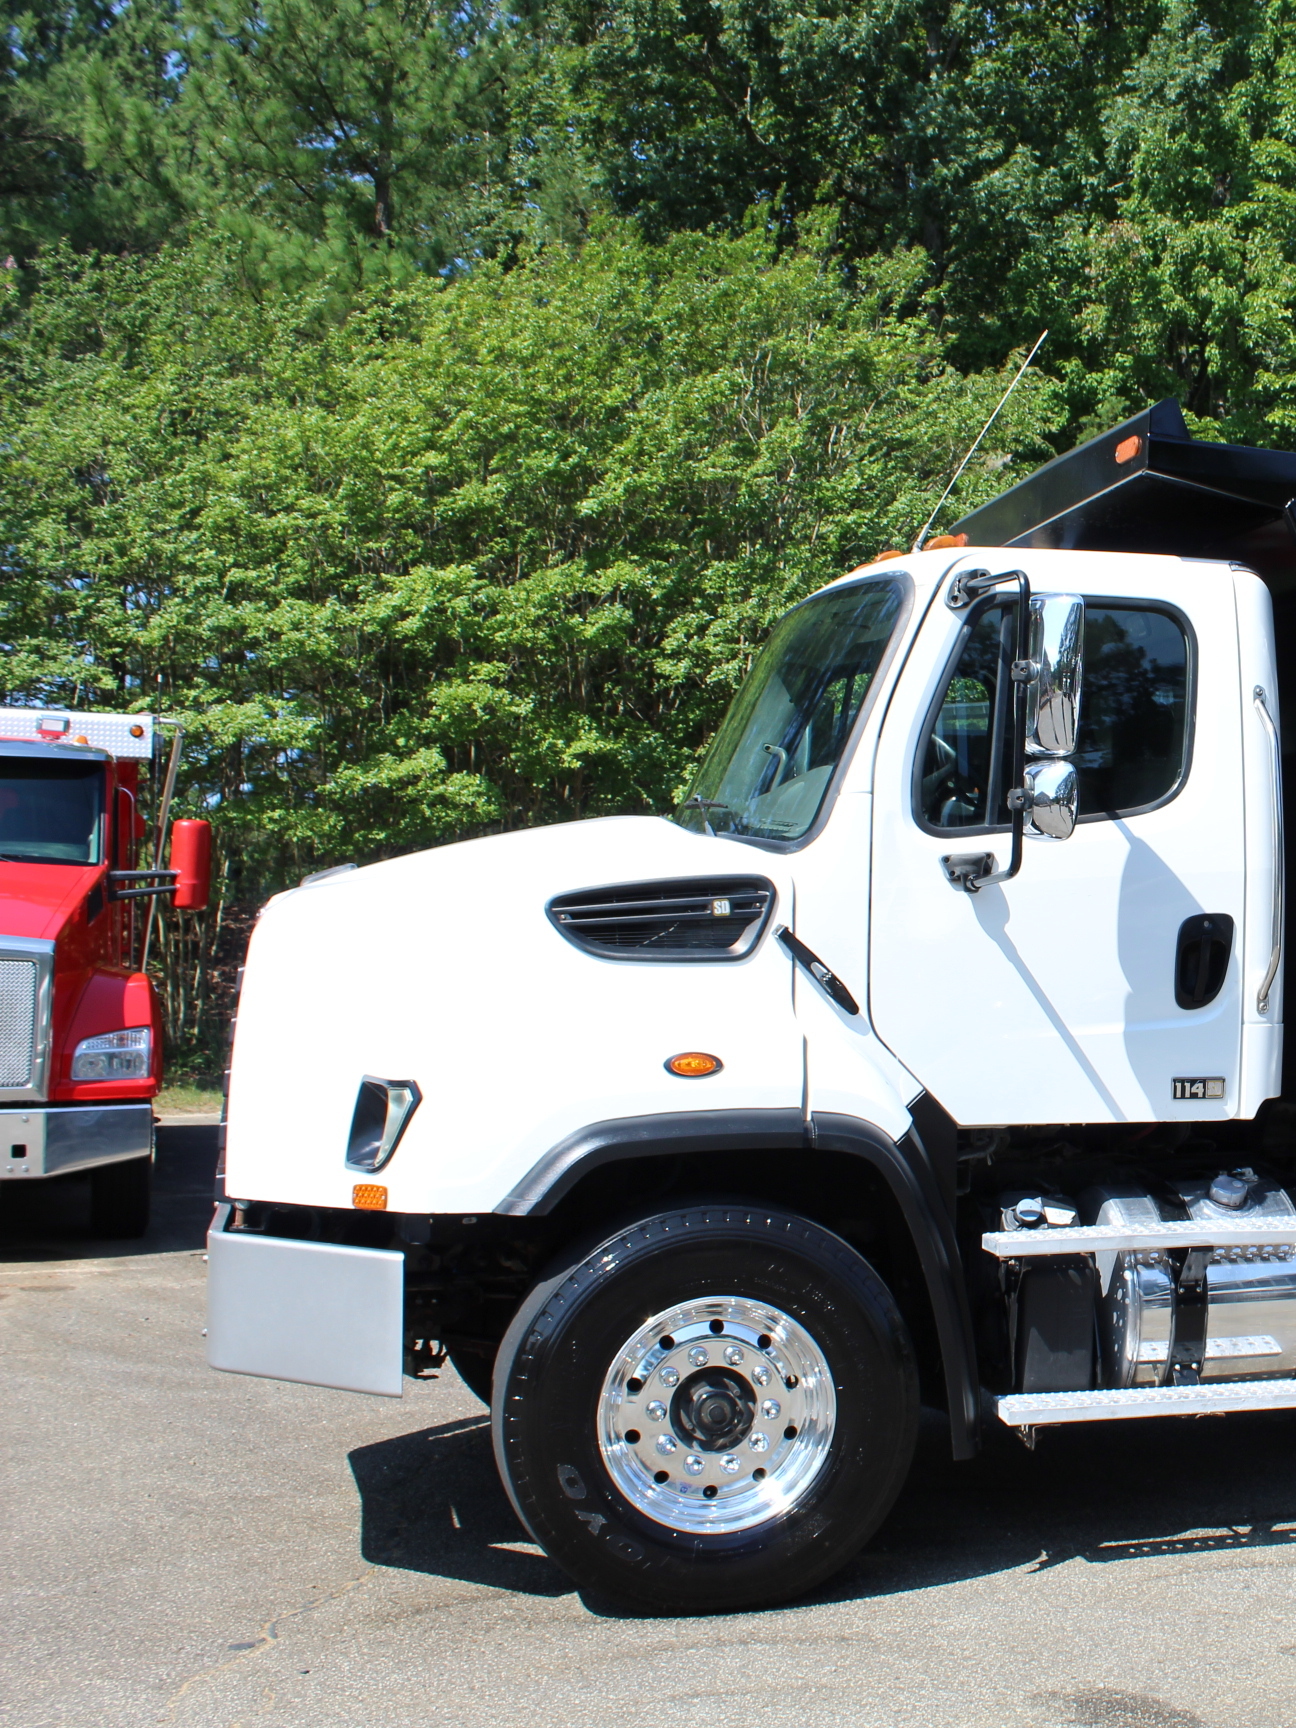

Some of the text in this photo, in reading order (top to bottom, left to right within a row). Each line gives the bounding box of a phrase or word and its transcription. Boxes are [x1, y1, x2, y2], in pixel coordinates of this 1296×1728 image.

[714, 900, 729, 914] SD
[1175, 1081, 1204, 1098] 114
[557, 1463, 672, 1569] OYO
